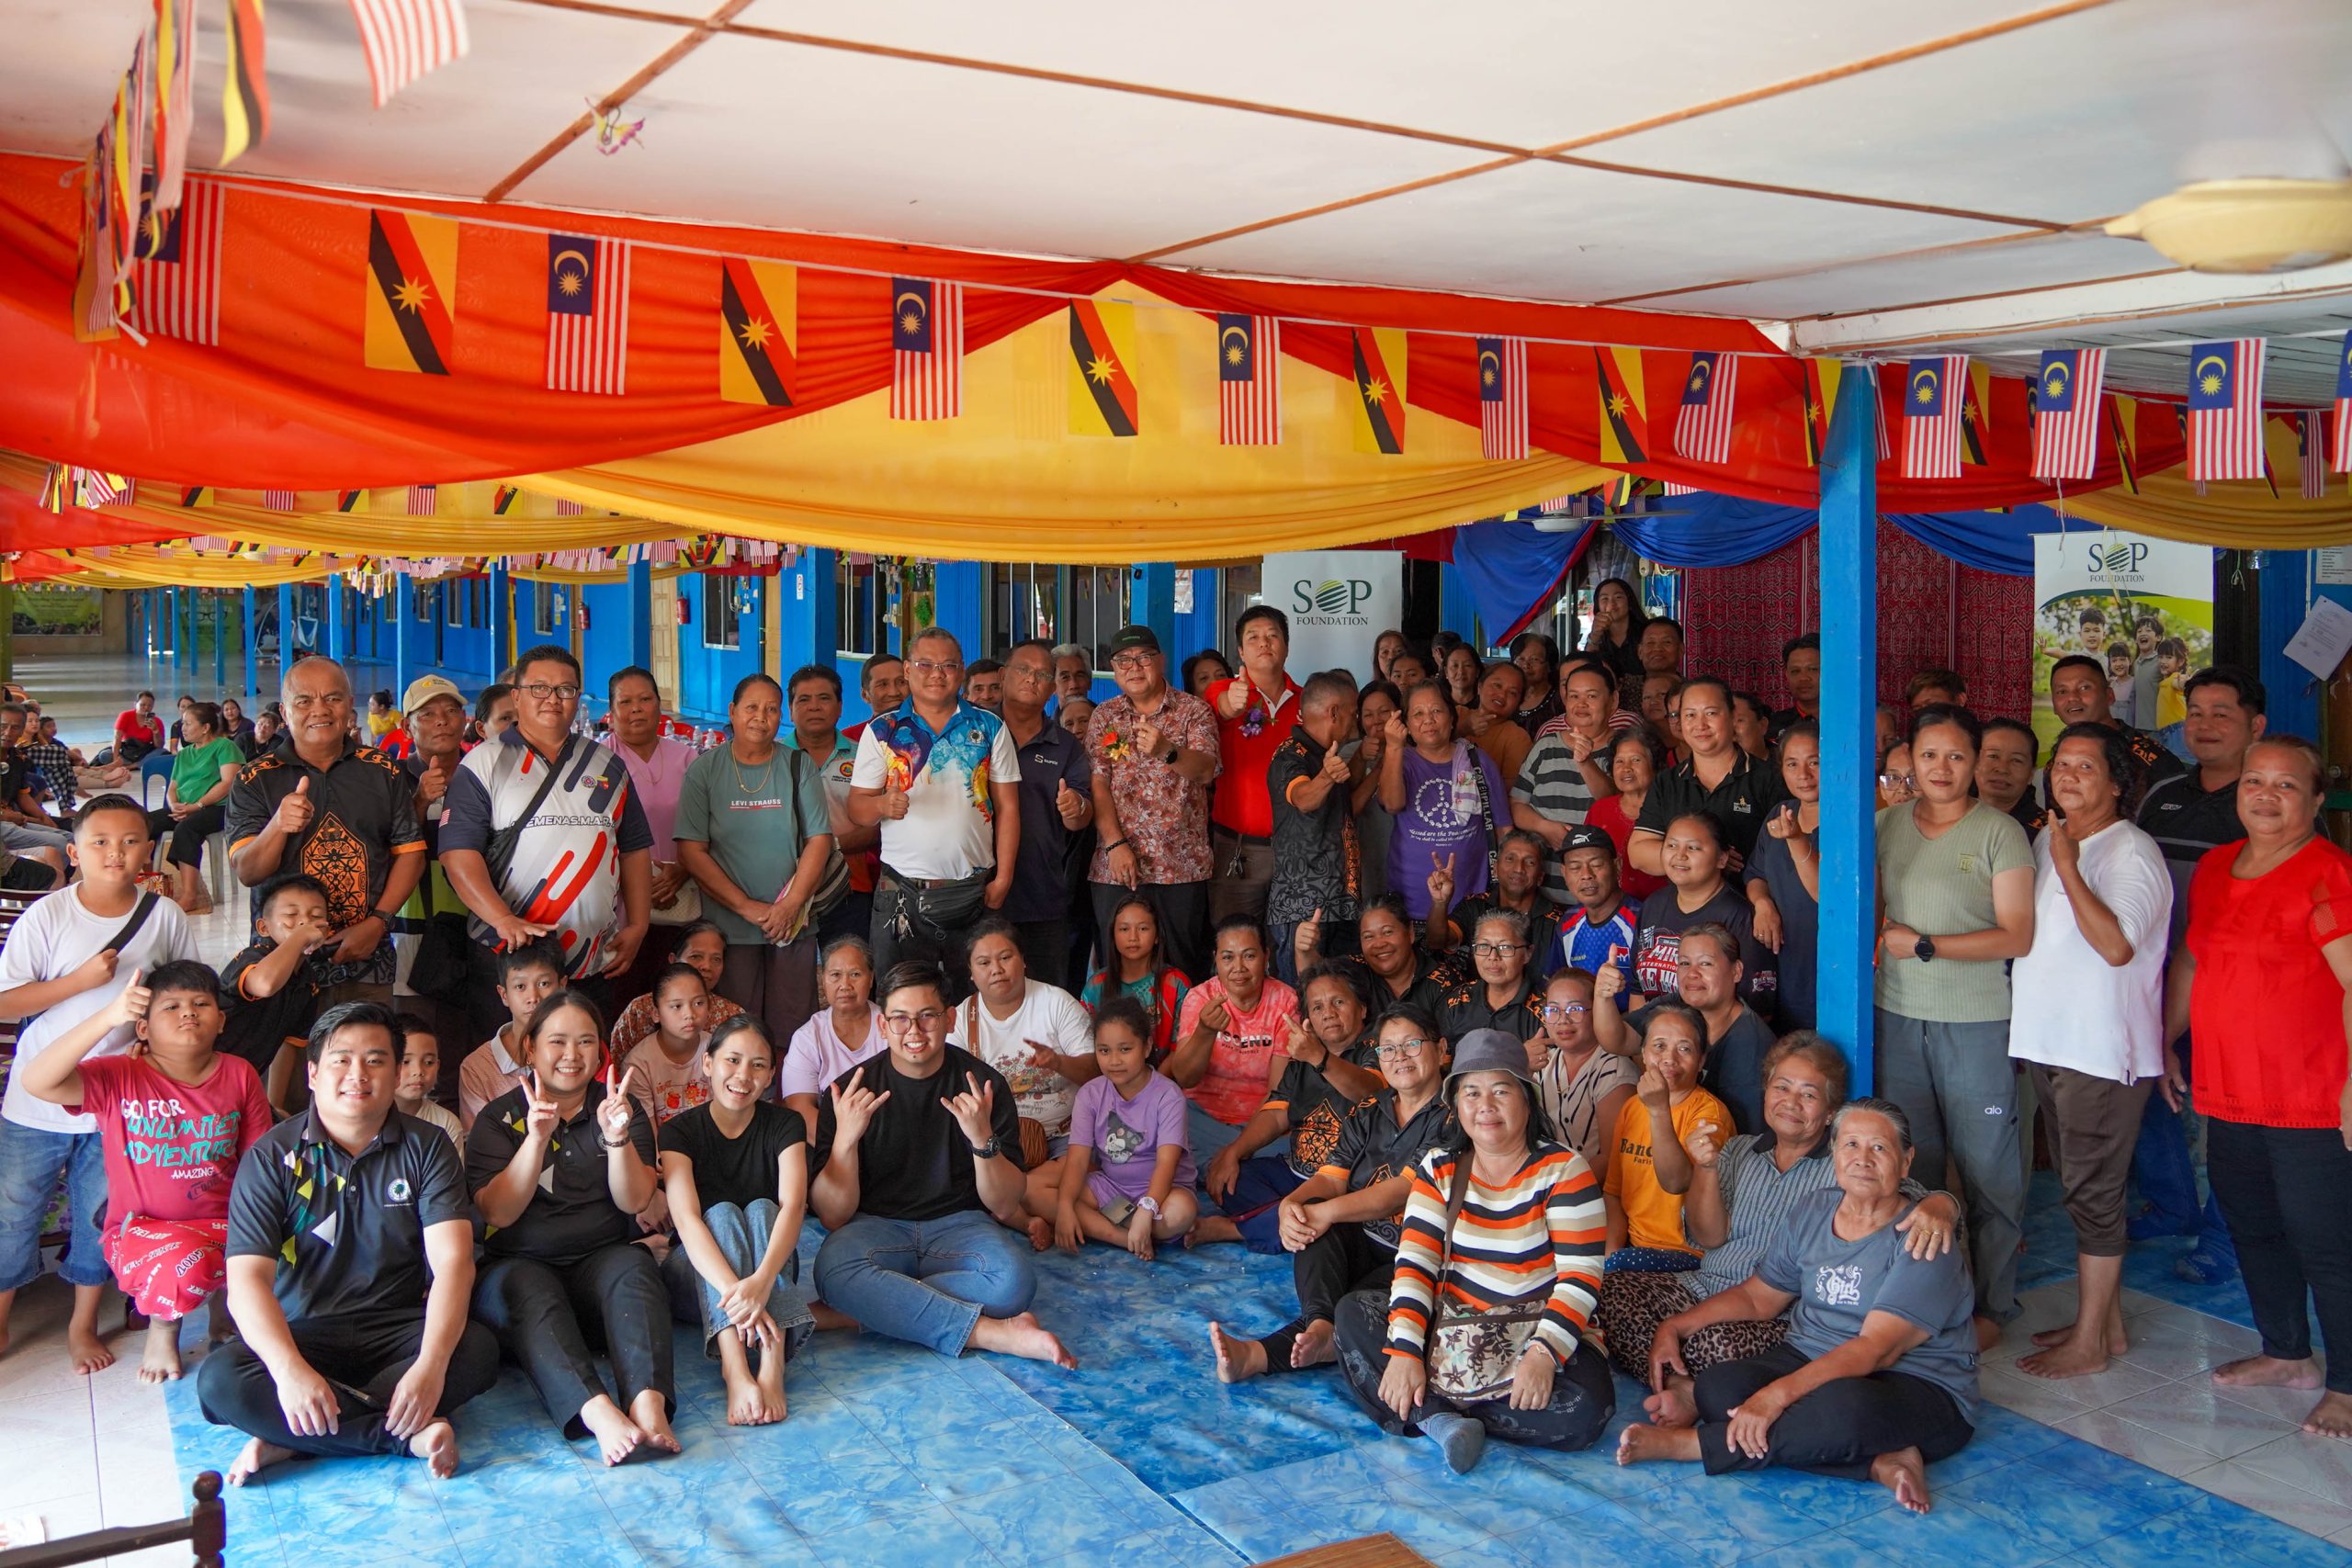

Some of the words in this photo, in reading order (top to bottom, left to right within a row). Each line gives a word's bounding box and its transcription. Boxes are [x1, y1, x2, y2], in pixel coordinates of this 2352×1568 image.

[2089, 574, 2144, 582] FOUDATION
[1296, 616, 1369, 626] FOUNDATION
[749, 798, 782, 807] STRAUSS
[1647, 944, 1679, 964] MIR
[1639, 961, 1679, 971] INTERNATIO
[120, 1098, 144, 1120] GO
[147, 1099, 186, 1119] FOR
[1984, 1105, 2003, 1115] alo
[171, 1167, 214, 1179] AMAZING
